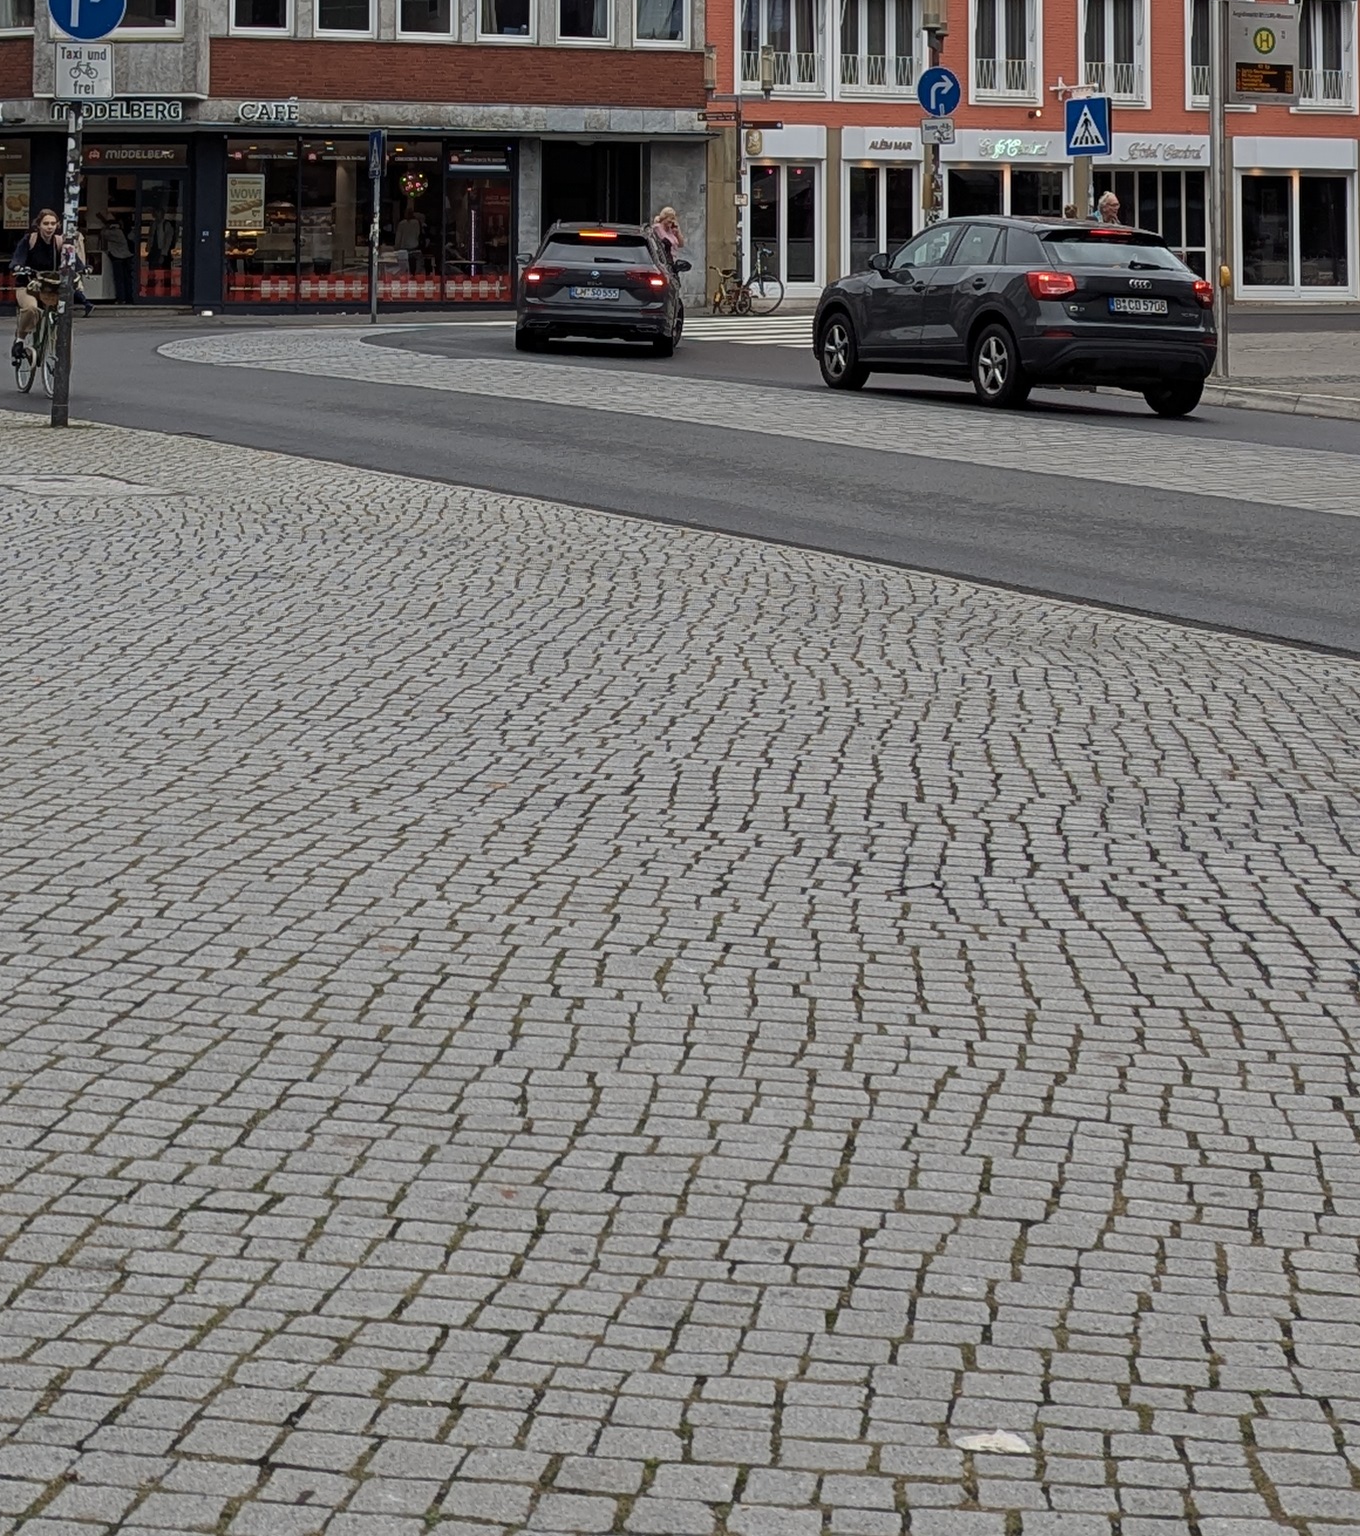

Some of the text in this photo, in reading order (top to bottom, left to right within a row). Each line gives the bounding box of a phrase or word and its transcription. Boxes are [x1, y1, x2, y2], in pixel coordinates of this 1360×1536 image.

[60, 46, 107, 61] Taxi und
[73, 80, 95, 95] frei
[50, 102, 181, 120] MDDELBERG
[893, 141, 913, 151] MAR
